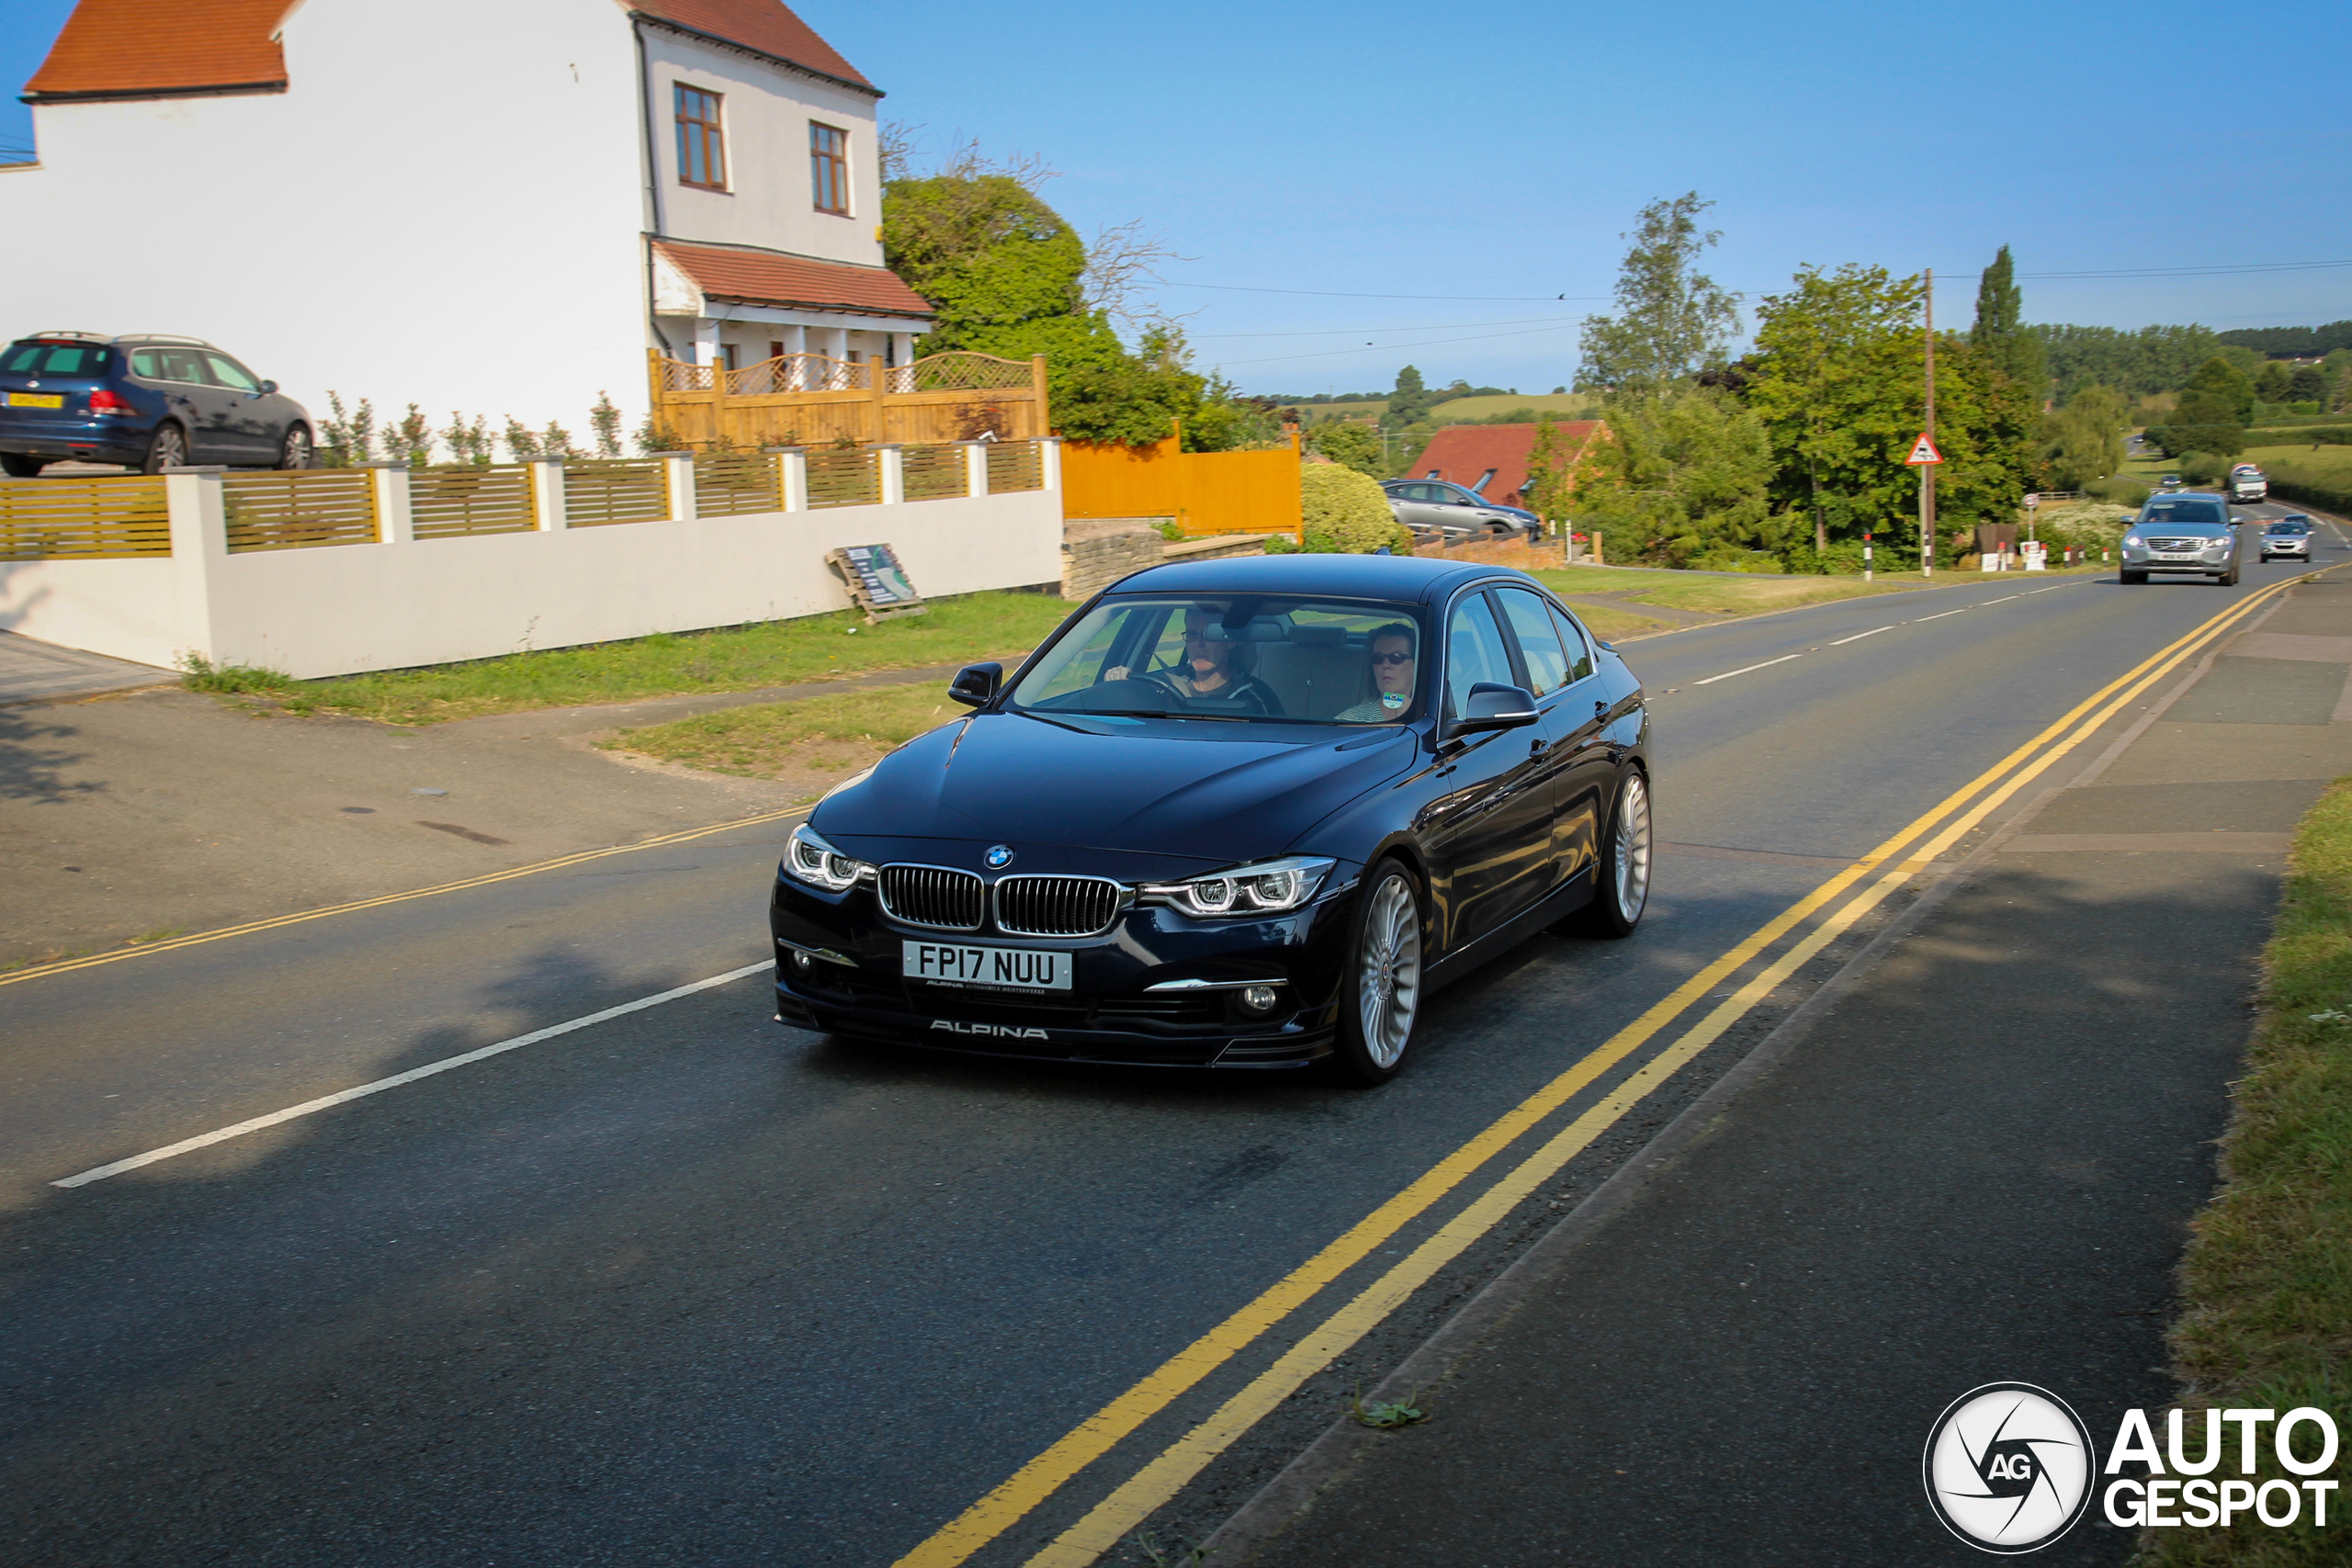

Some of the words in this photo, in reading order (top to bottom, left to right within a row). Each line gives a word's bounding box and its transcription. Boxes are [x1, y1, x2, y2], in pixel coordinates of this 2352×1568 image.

[920, 945, 984, 978] FP17
[995, 952, 1055, 985] NUU
[926, 980, 964, 988] ALPINA
[966, 984, 1001, 992] AUTOMOBILE
[930, 1020, 1049, 1040] ALPINA
